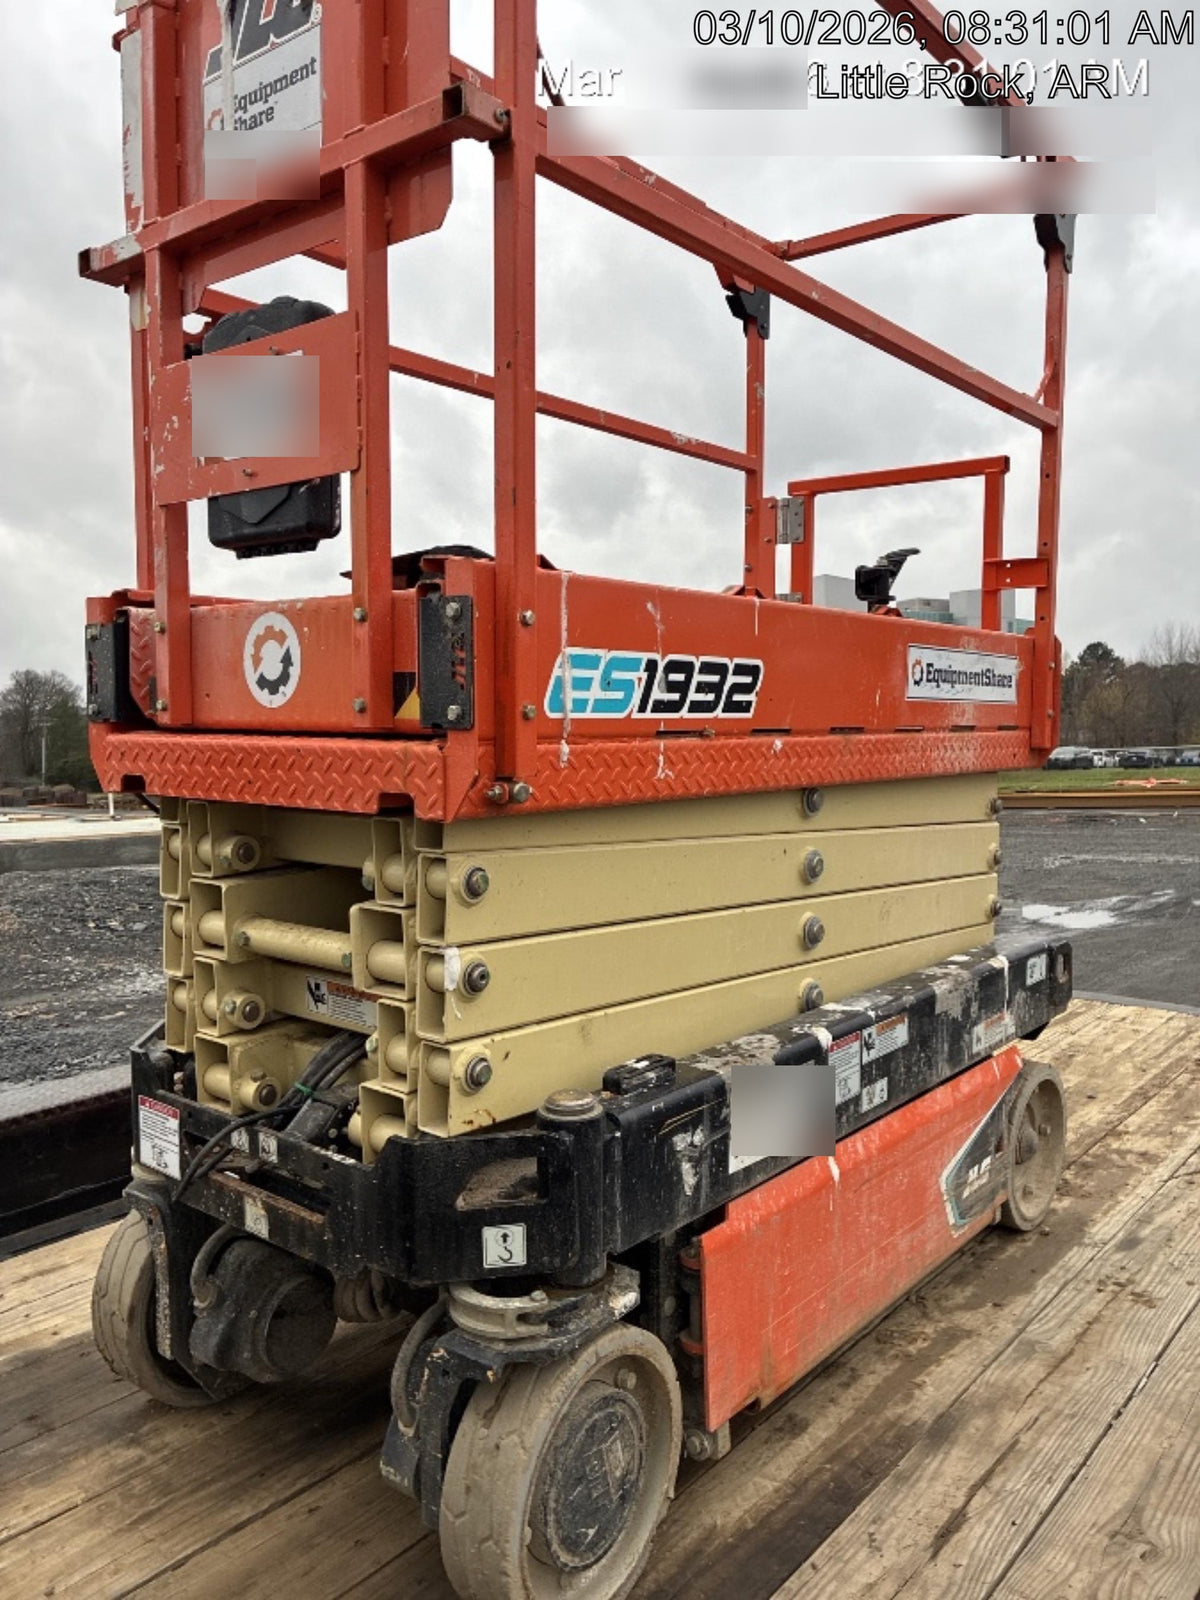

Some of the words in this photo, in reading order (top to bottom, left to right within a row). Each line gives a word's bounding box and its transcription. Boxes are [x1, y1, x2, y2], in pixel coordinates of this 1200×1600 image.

[233, 106, 275, 131] hare
[546, 649, 762, 716] ES1932
[926, 662, 1013, 689] EquipmentShare
